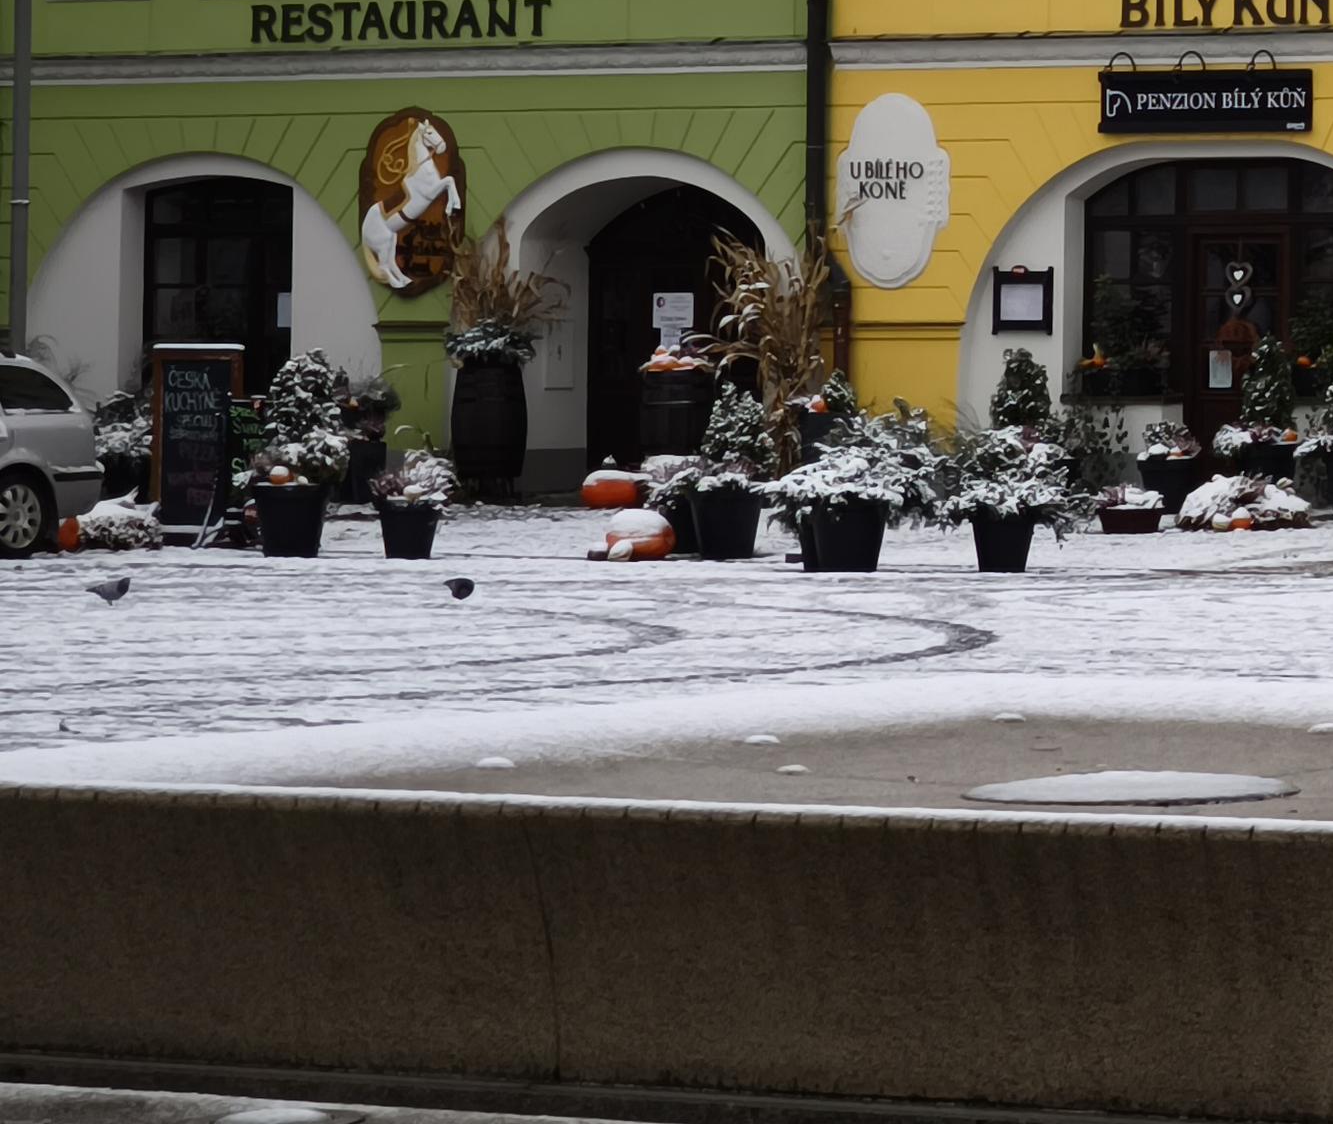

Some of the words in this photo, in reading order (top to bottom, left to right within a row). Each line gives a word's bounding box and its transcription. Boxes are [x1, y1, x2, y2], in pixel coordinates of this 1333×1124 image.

[1136, 92, 1217, 110] PENZION
[1221, 87, 1263, 109] BÍLÝ
[1267, 87, 1306, 108] KŮŇ
[850, 161, 861, 179] U
[865, 158, 924, 180] BÍLÉHO
[859, 180, 906, 200] KONĚ
